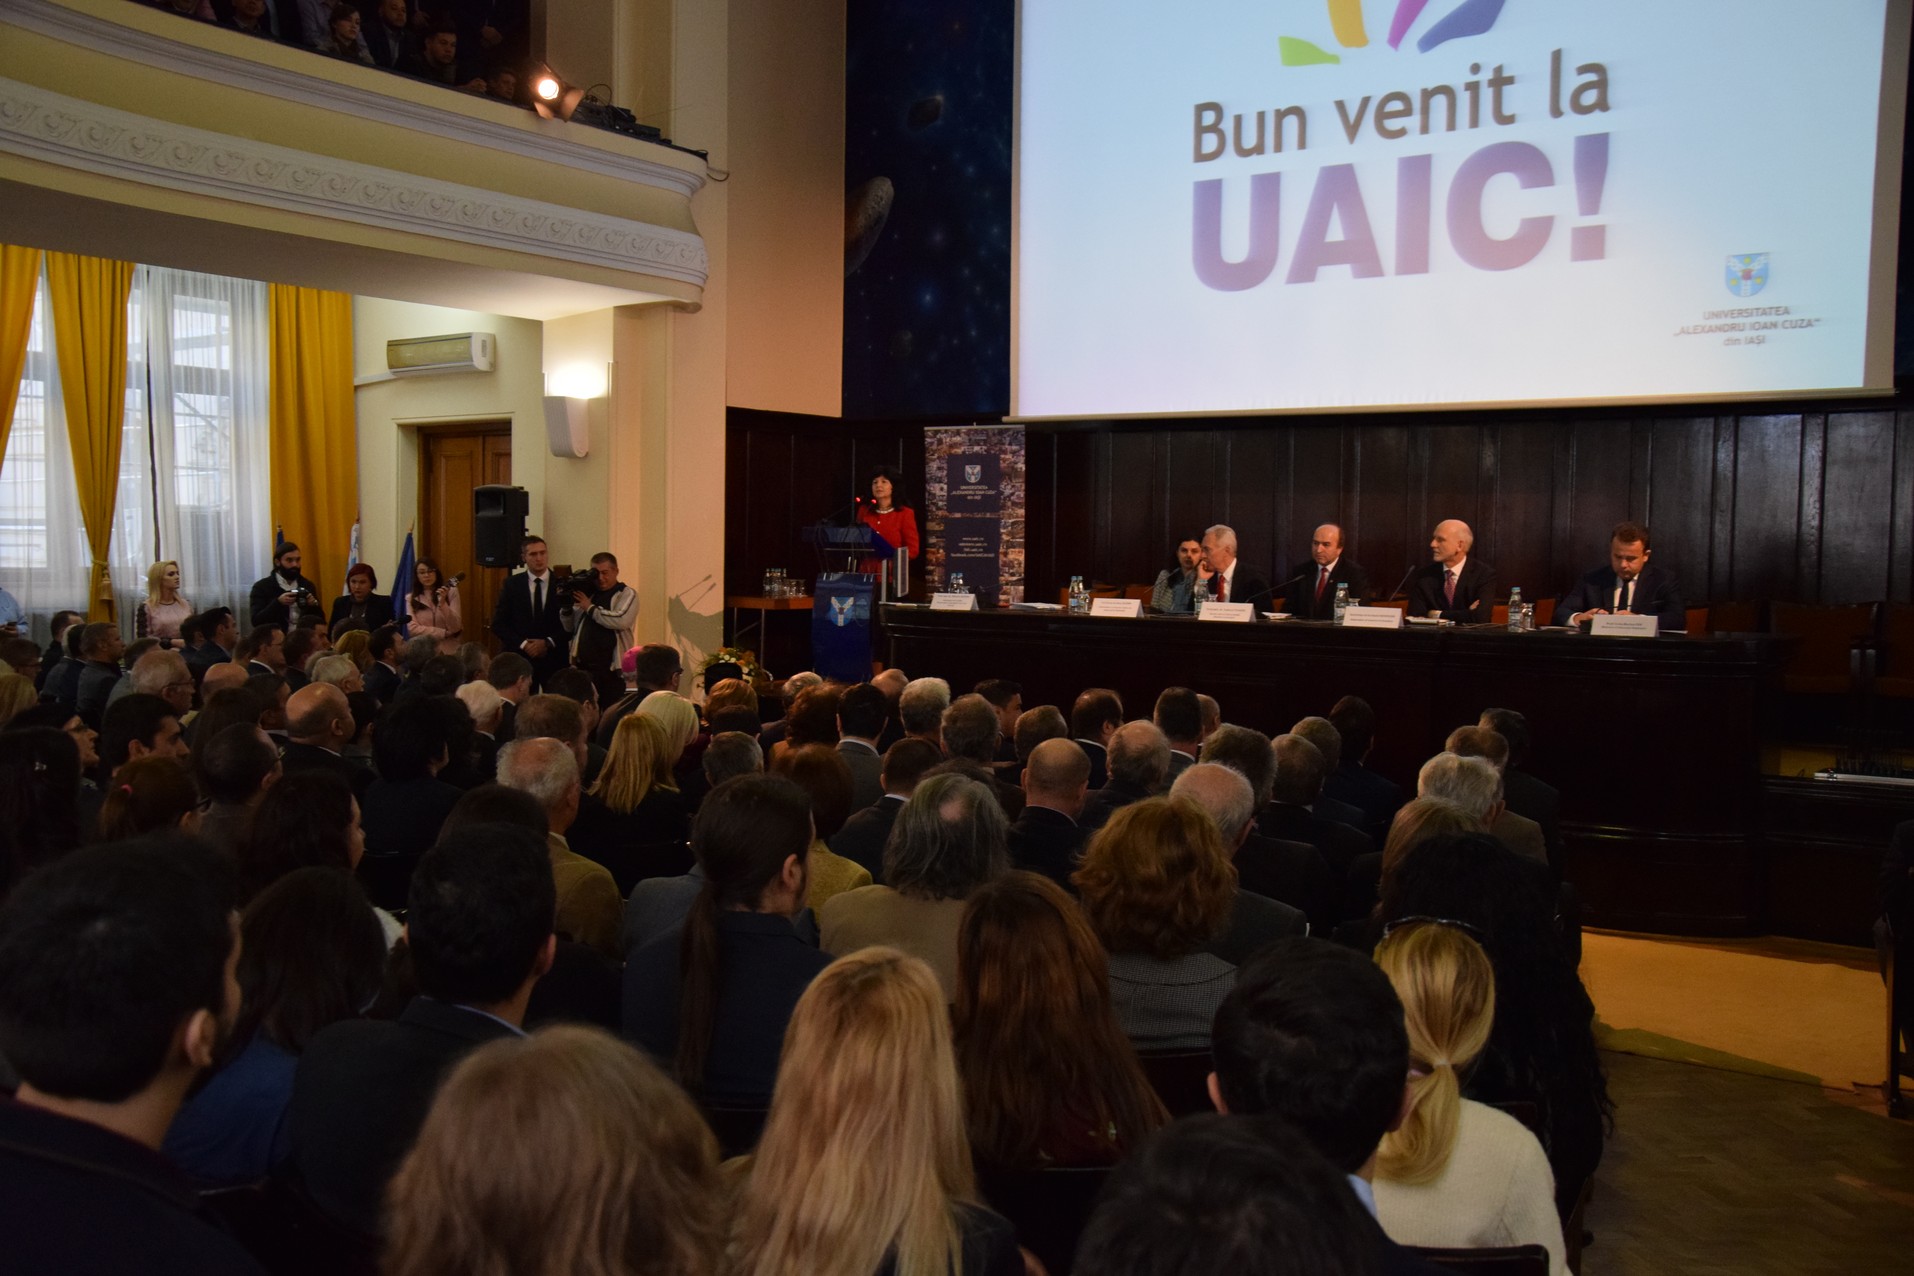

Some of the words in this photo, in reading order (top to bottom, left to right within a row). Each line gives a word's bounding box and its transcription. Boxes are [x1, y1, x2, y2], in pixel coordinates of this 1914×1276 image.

[1193, 101, 1307, 163] Bun
[1334, 62, 1515, 145] venit
[1549, 48, 1611, 118] la
[1192, 132, 1610, 292] UAIC!
[1703, 306, 1791, 320] UNIVERSITATEA
[1749, 321, 1778, 332] IOAN
[1723, 336, 1741, 346] din
